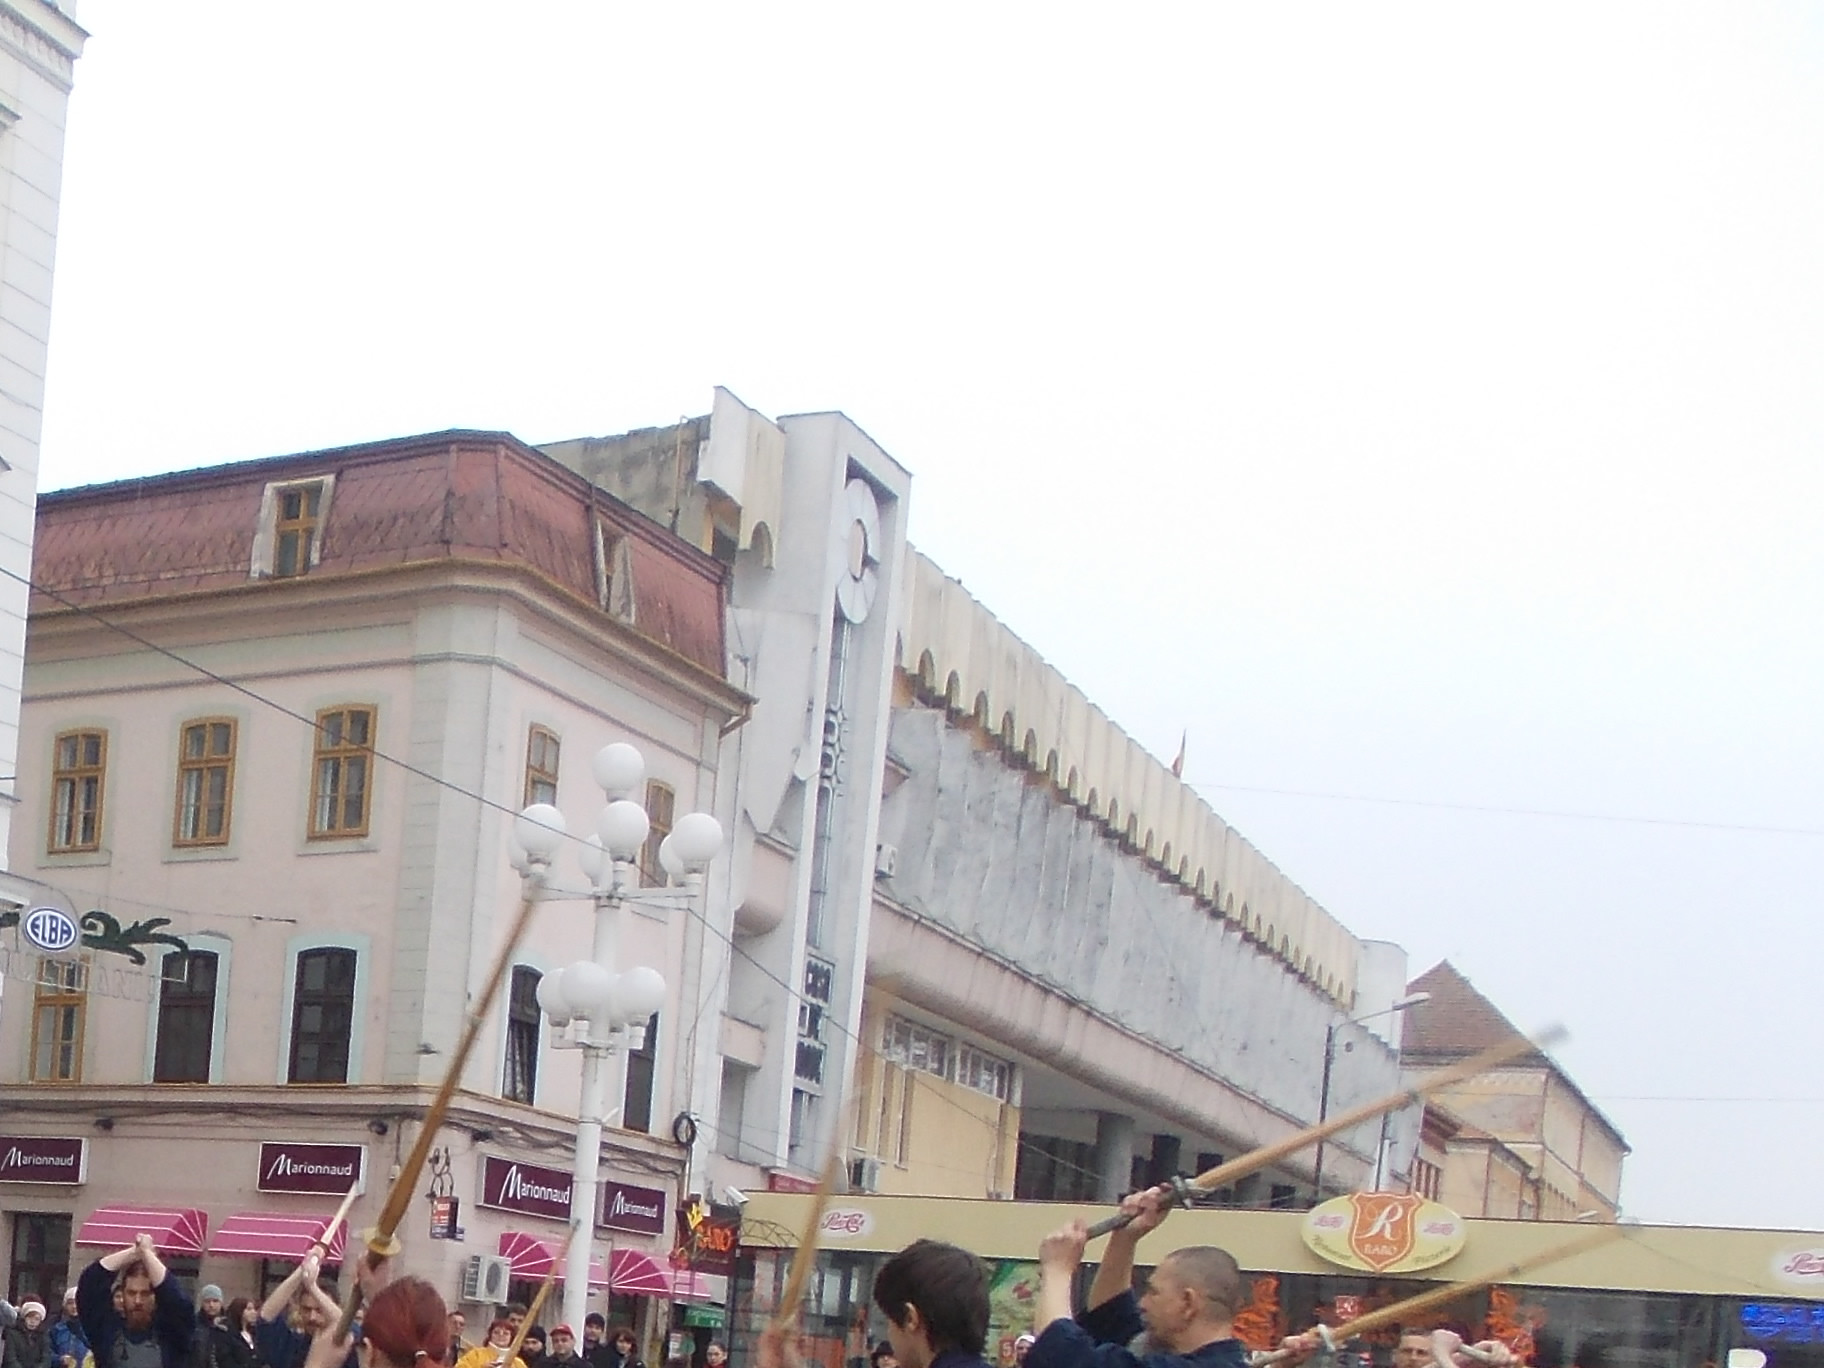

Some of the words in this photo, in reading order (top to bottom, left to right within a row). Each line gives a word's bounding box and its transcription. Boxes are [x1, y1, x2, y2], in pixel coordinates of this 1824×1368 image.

[30, 916, 72, 945] ELBA
[0, 1145, 74, 1172] Marionnaud
[266, 1152, 353, 1180] Marionnaud
[498, 1164, 571, 1206] Marionnaud
[609, 1190, 658, 1219] Marionnaud
